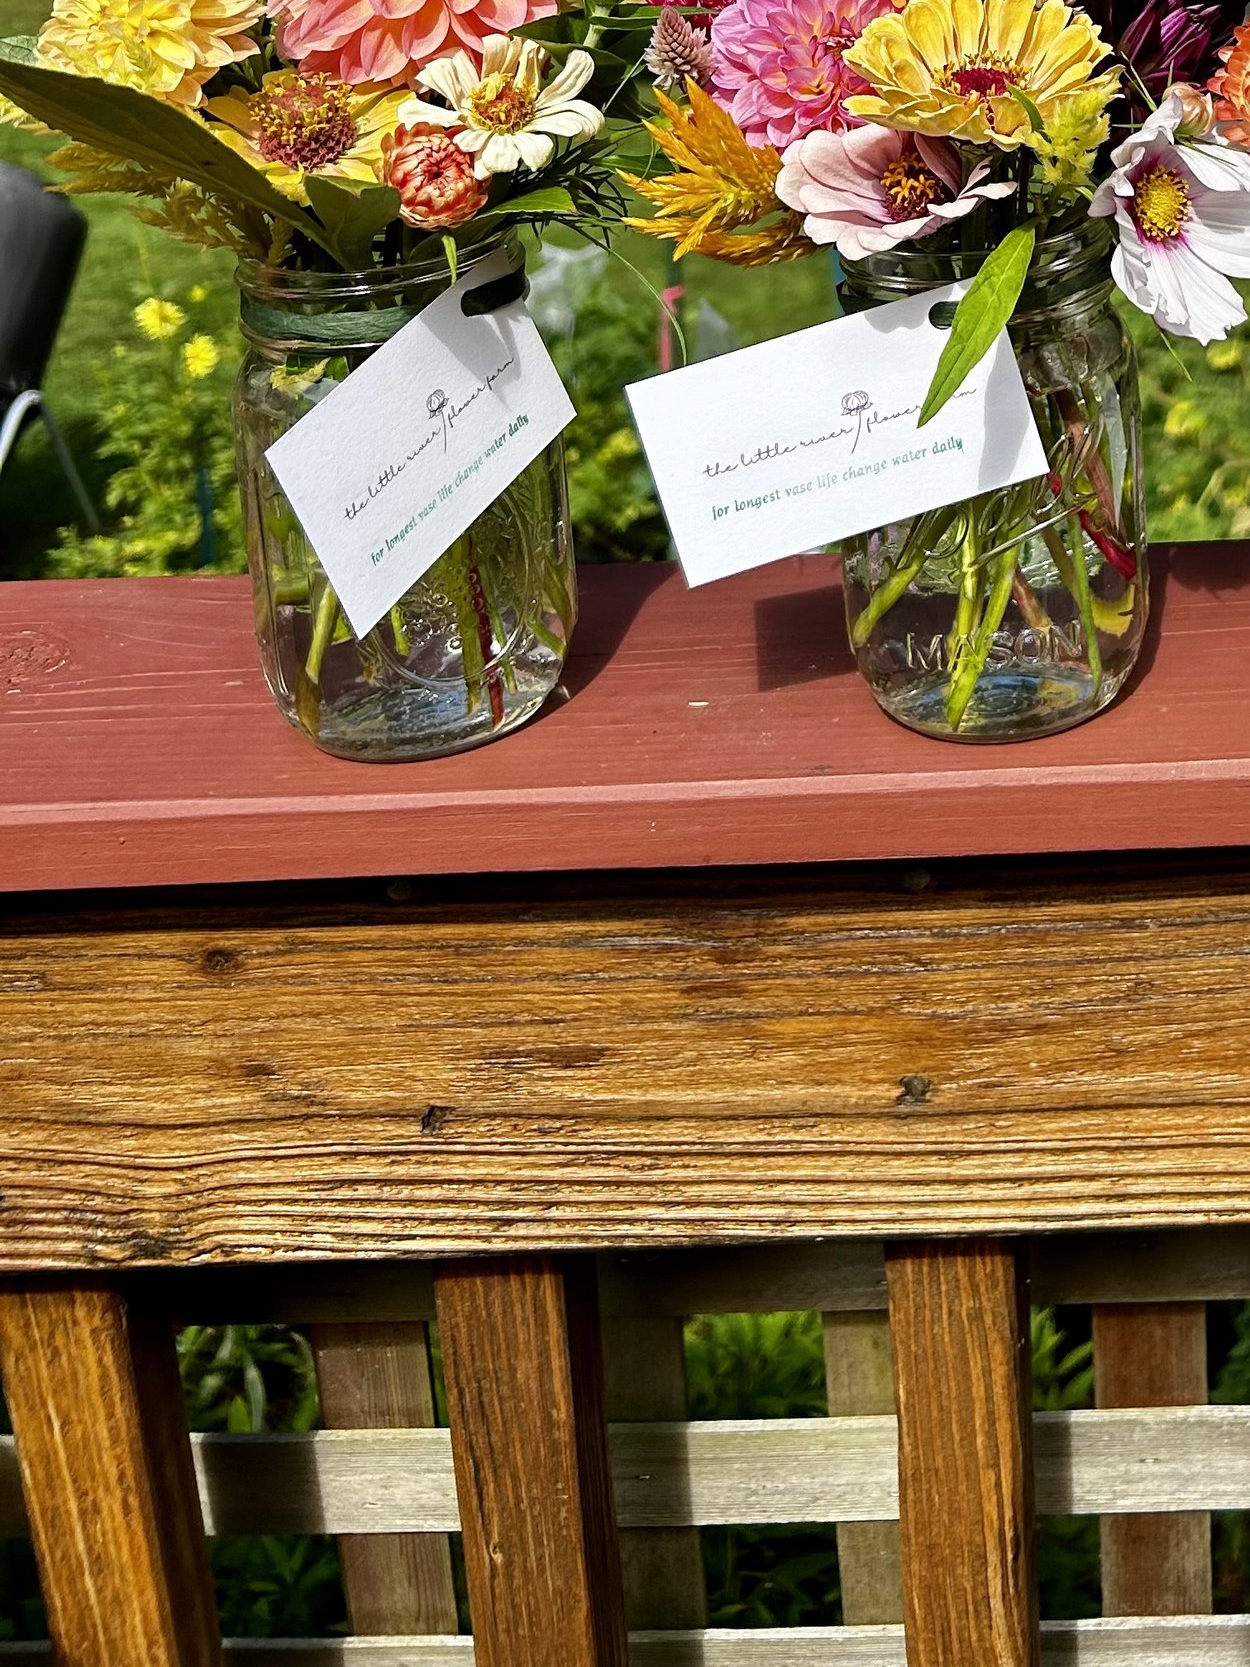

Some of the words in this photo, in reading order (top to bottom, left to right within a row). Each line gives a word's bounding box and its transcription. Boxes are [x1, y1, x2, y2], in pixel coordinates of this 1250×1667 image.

[344, 498, 370, 520] the
[368, 462, 406, 497] little
[407, 427, 441, 460] river
[448, 383, 486, 428] flower
[486, 357, 514, 390] farm
[703, 460, 739, 477] the
[740, 443, 797, 466] little
[800, 427, 852, 447] river
[866, 404, 922, 433] flower
[712, 505, 729, 520] for
[735, 489, 781, 512] longest
[786, 481, 813, 497] vase
[817, 472, 837, 488] life
[842, 460, 887, 482] change
[892, 448, 927, 467] water
[932, 436, 964, 454] daily
[371, 547, 384, 566] for
[385, 518, 418, 551] longest
[418, 501, 437, 520] vase
[438, 485, 453, 502] life
[454, 456, 484, 487] change
[484, 432, 507, 460] water
[508, 413, 529, 436] daily
[905, 619, 1083, 670] MASON
